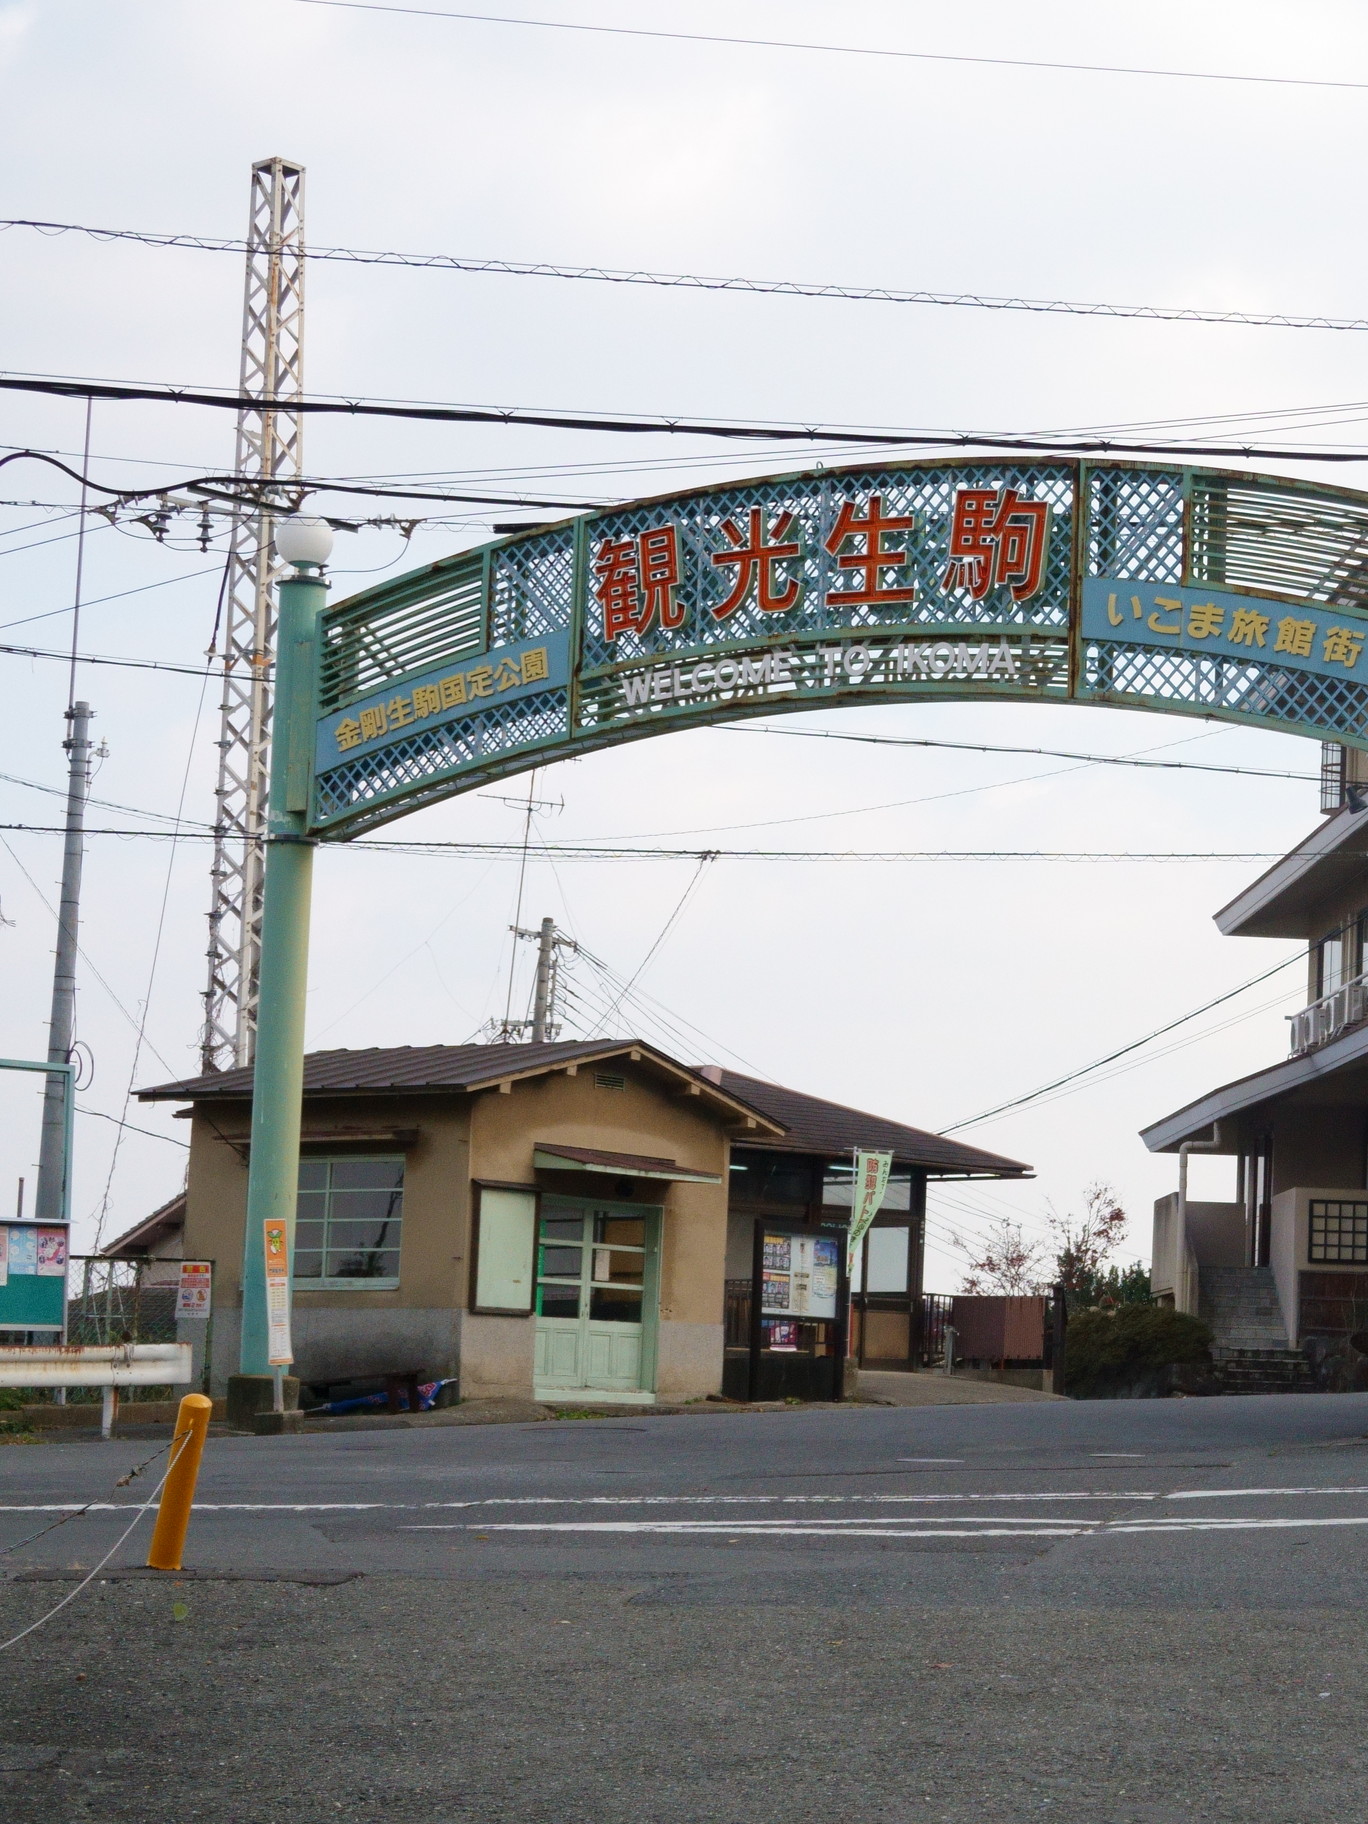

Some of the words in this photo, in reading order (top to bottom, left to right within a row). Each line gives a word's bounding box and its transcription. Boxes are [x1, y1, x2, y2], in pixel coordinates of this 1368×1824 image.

[595, 488, 1050, 643] 観光生駒
[622, 651, 793, 706] WELCOME
[819, 645, 870, 678] TO
[898, 641, 1017, 675] IKOMA
[1107, 592, 1367, 669] いこま旅館街
[334, 647, 550, 753] 金剛生駒国定公園
